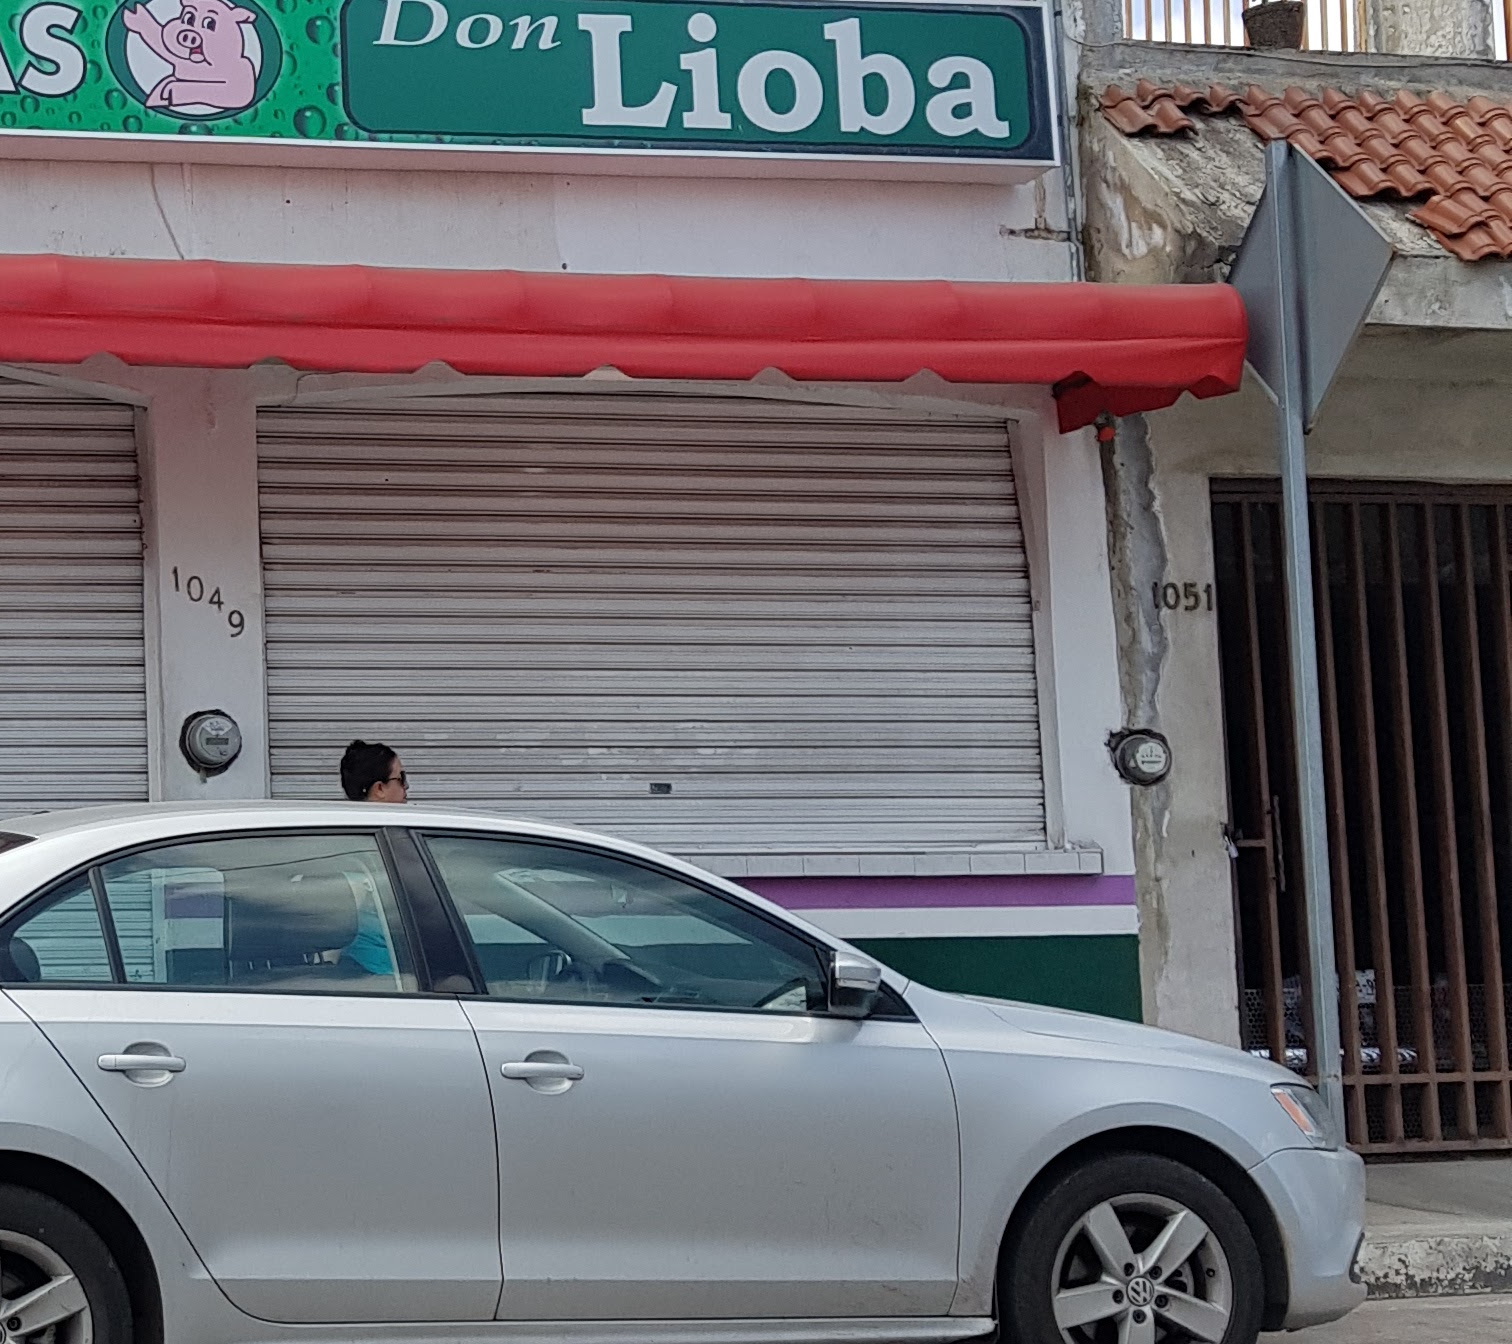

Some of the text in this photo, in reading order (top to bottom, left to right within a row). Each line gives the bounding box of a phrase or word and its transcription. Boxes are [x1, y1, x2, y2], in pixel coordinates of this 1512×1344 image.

[578, 12, 1009, 140] Lioba
[172, 566, 245, 638] 1049
[1152, 581, 1213, 612] 1051
